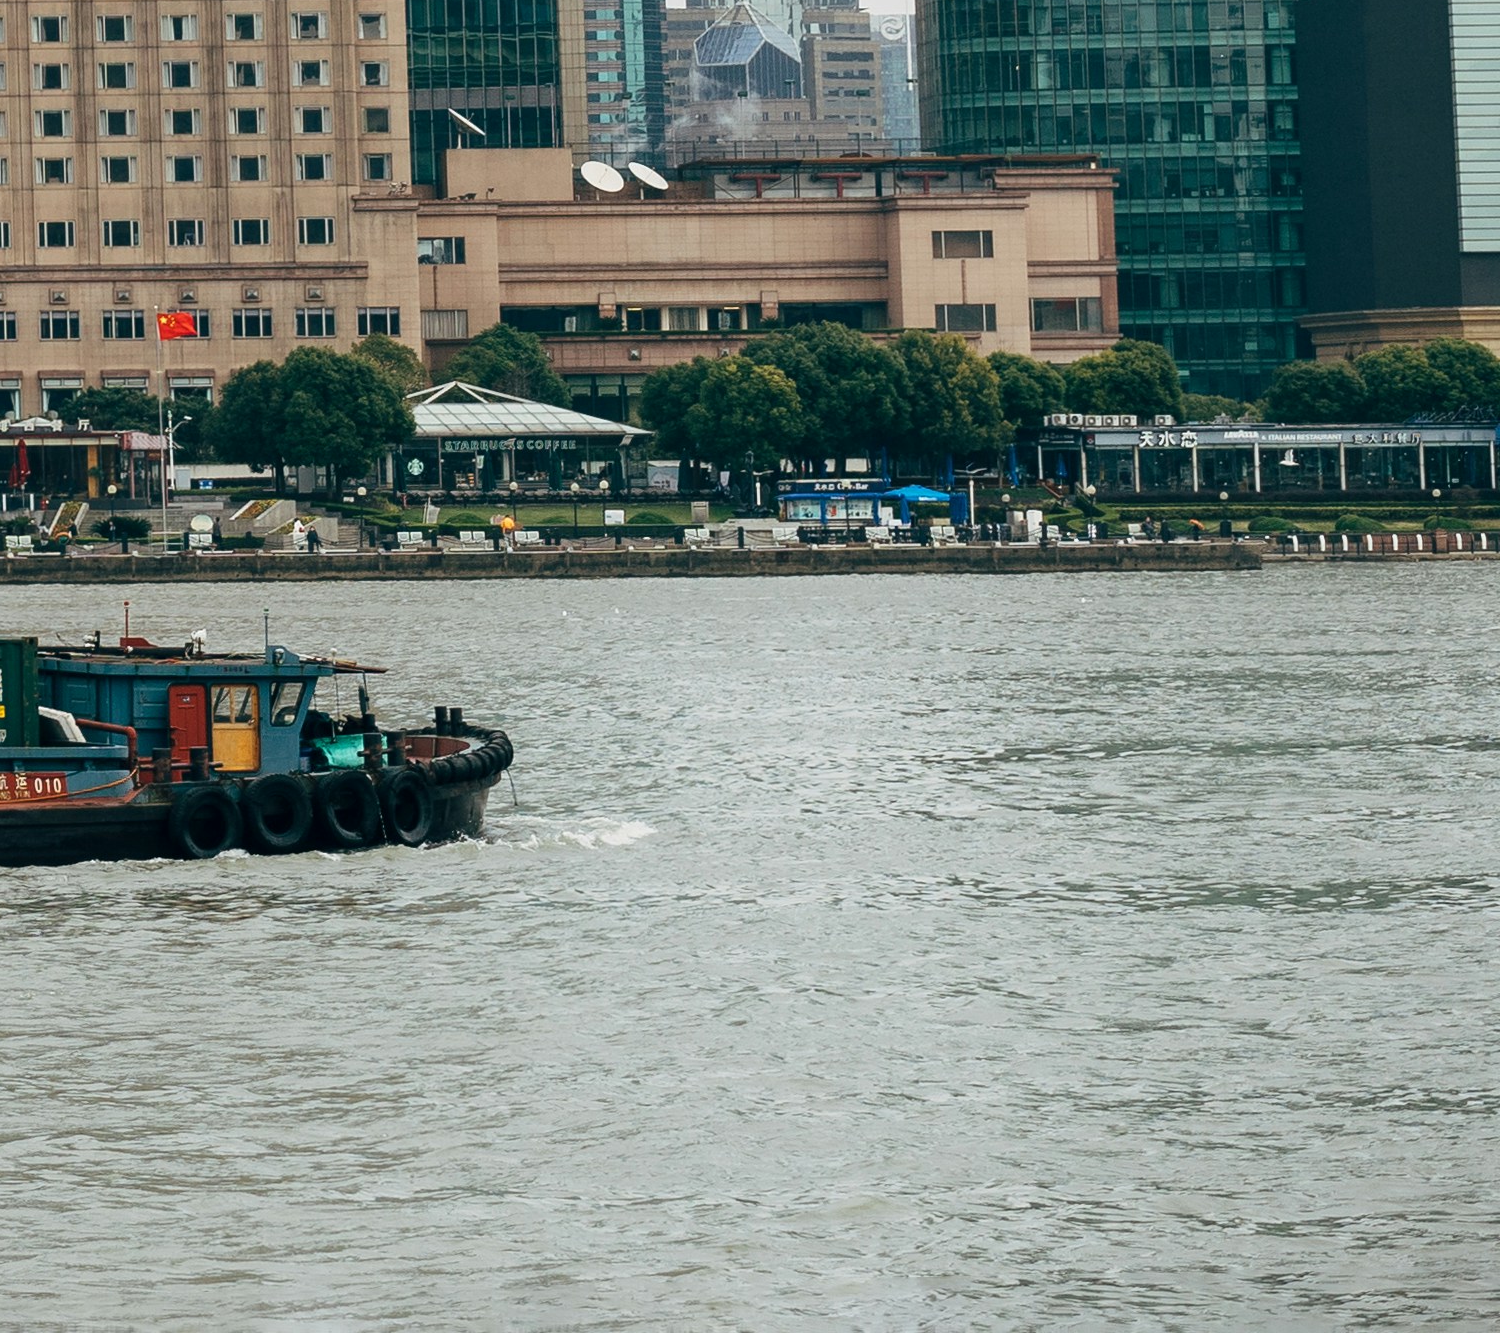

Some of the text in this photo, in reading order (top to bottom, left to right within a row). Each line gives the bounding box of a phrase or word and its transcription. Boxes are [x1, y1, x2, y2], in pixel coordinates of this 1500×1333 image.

[1139, 430, 1199, 448] 天水恋
[1268, 433, 1296, 442] ITALIAN
[1297, 432, 1342, 441] RESTAURANT
[526, 439, 577, 452] COFFEE
[34, 777, 62, 794] 010
